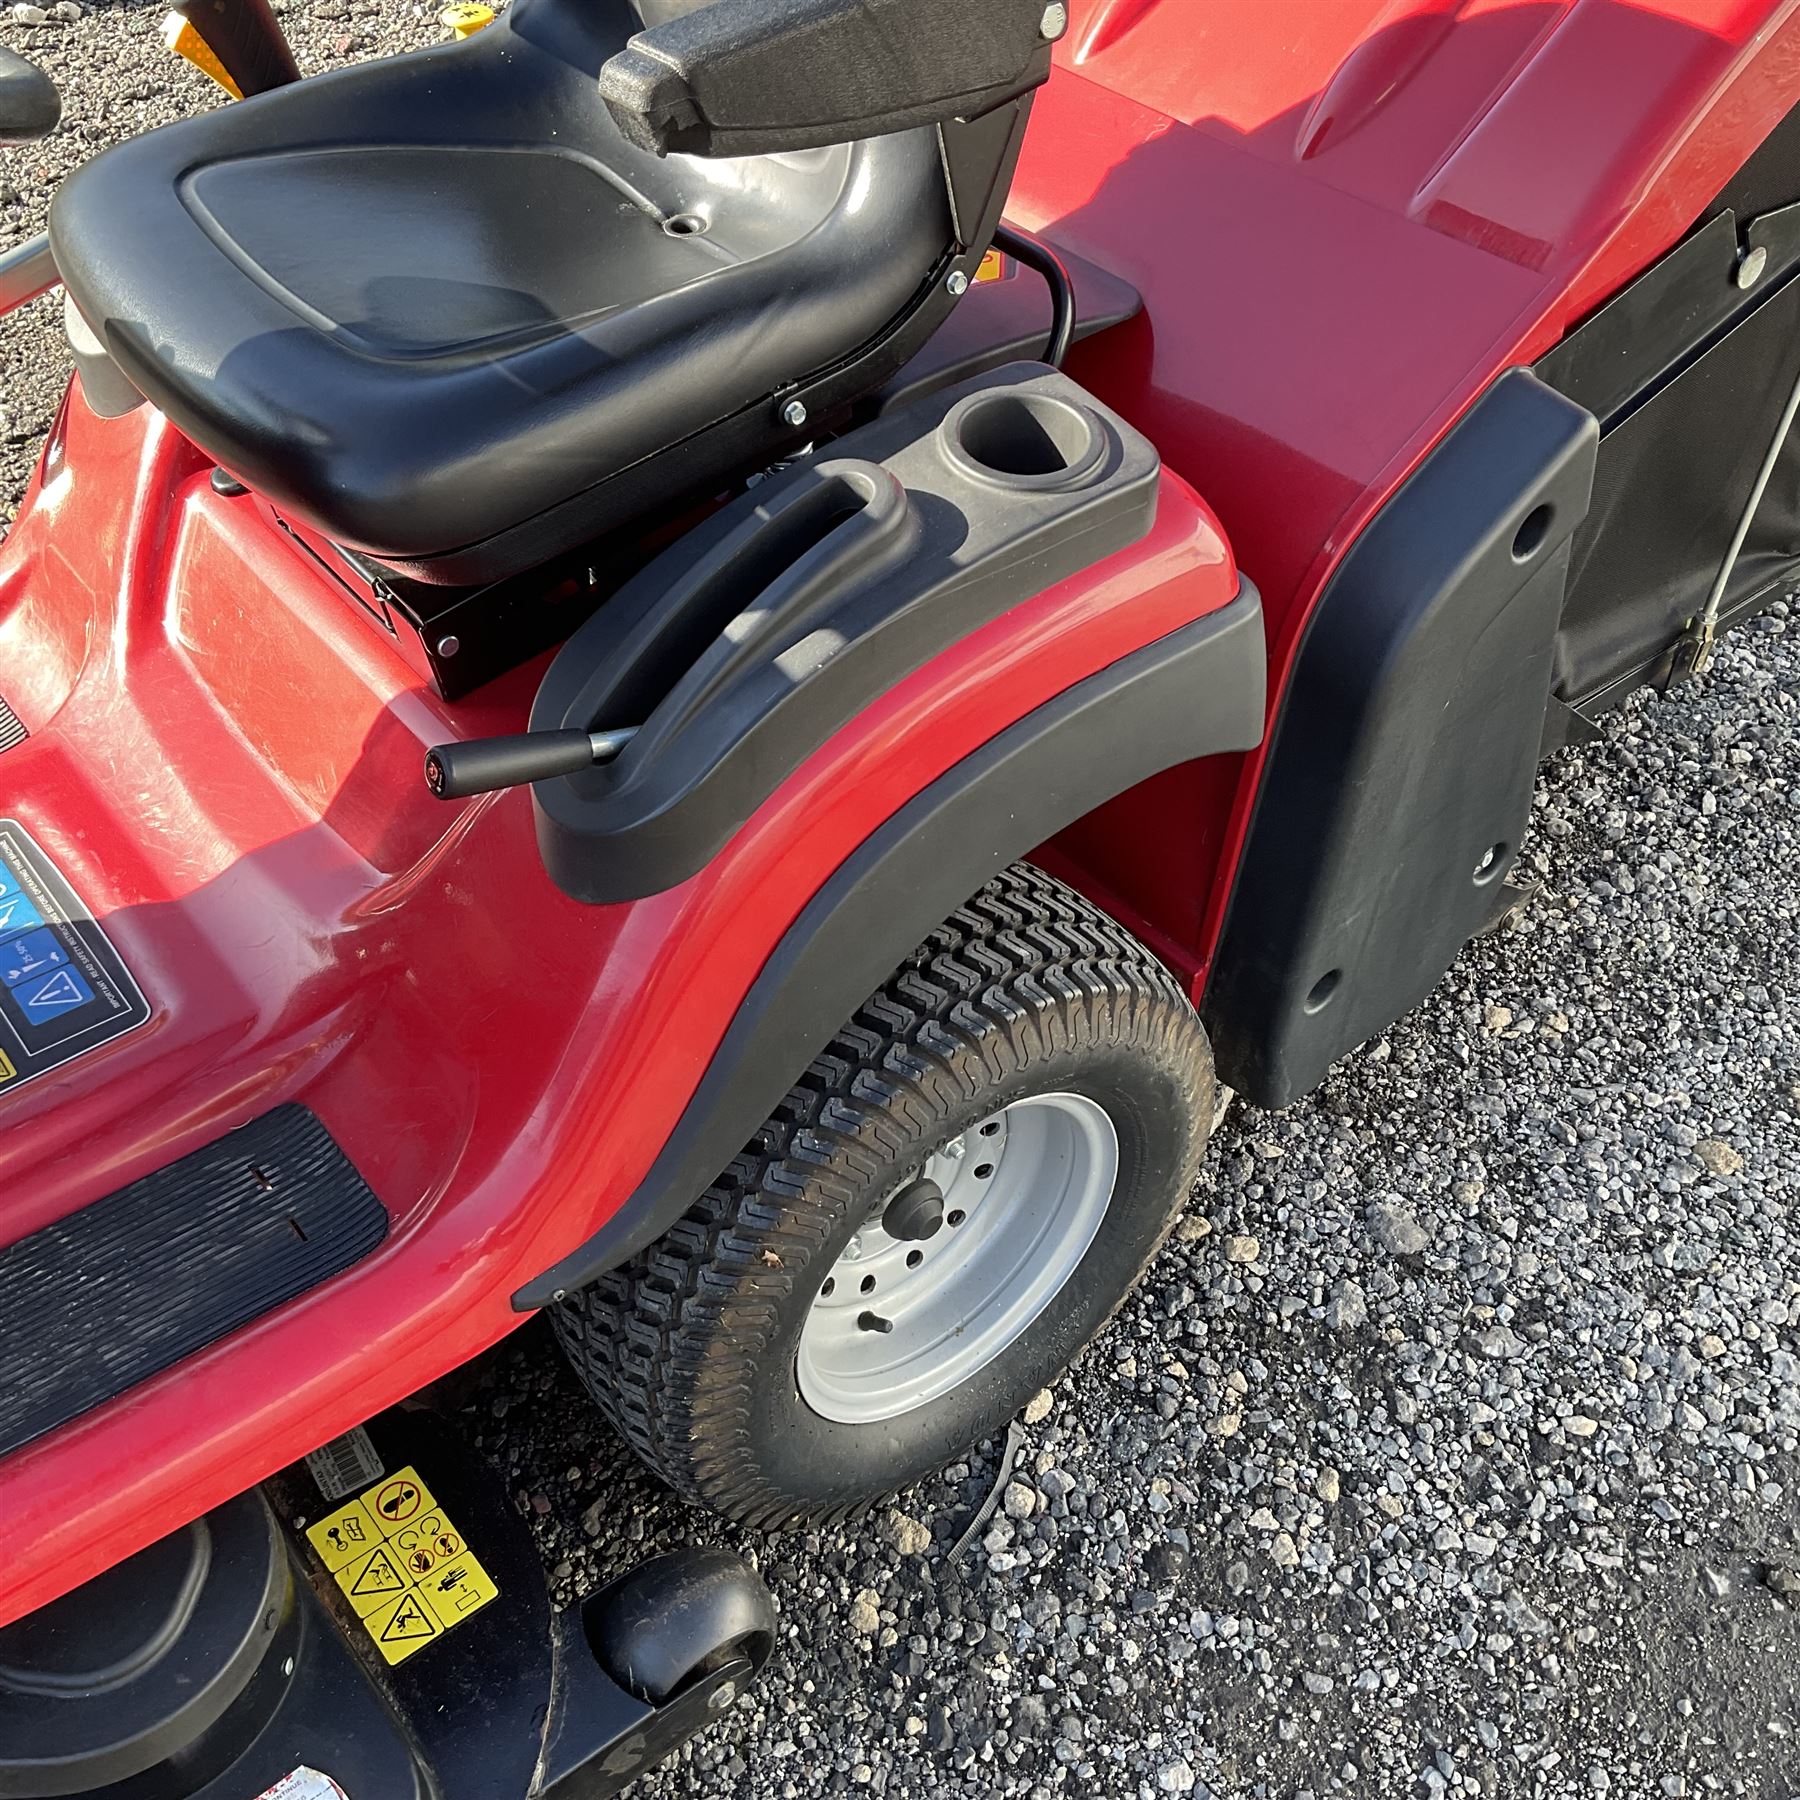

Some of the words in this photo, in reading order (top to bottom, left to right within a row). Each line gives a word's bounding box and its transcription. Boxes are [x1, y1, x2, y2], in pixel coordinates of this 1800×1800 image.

[12, 858, 24, 872] THIS
[20, 869, 42, 896] OPERATING
[37, 894, 55, 914] BEFORE
[50, 912, 77, 947] INSTRUCTIONS
[73, 945, 90, 965] SAFETY
[85, 963, 99, 978] READ
[96, 980, 121, 1009] IMPORTANT
